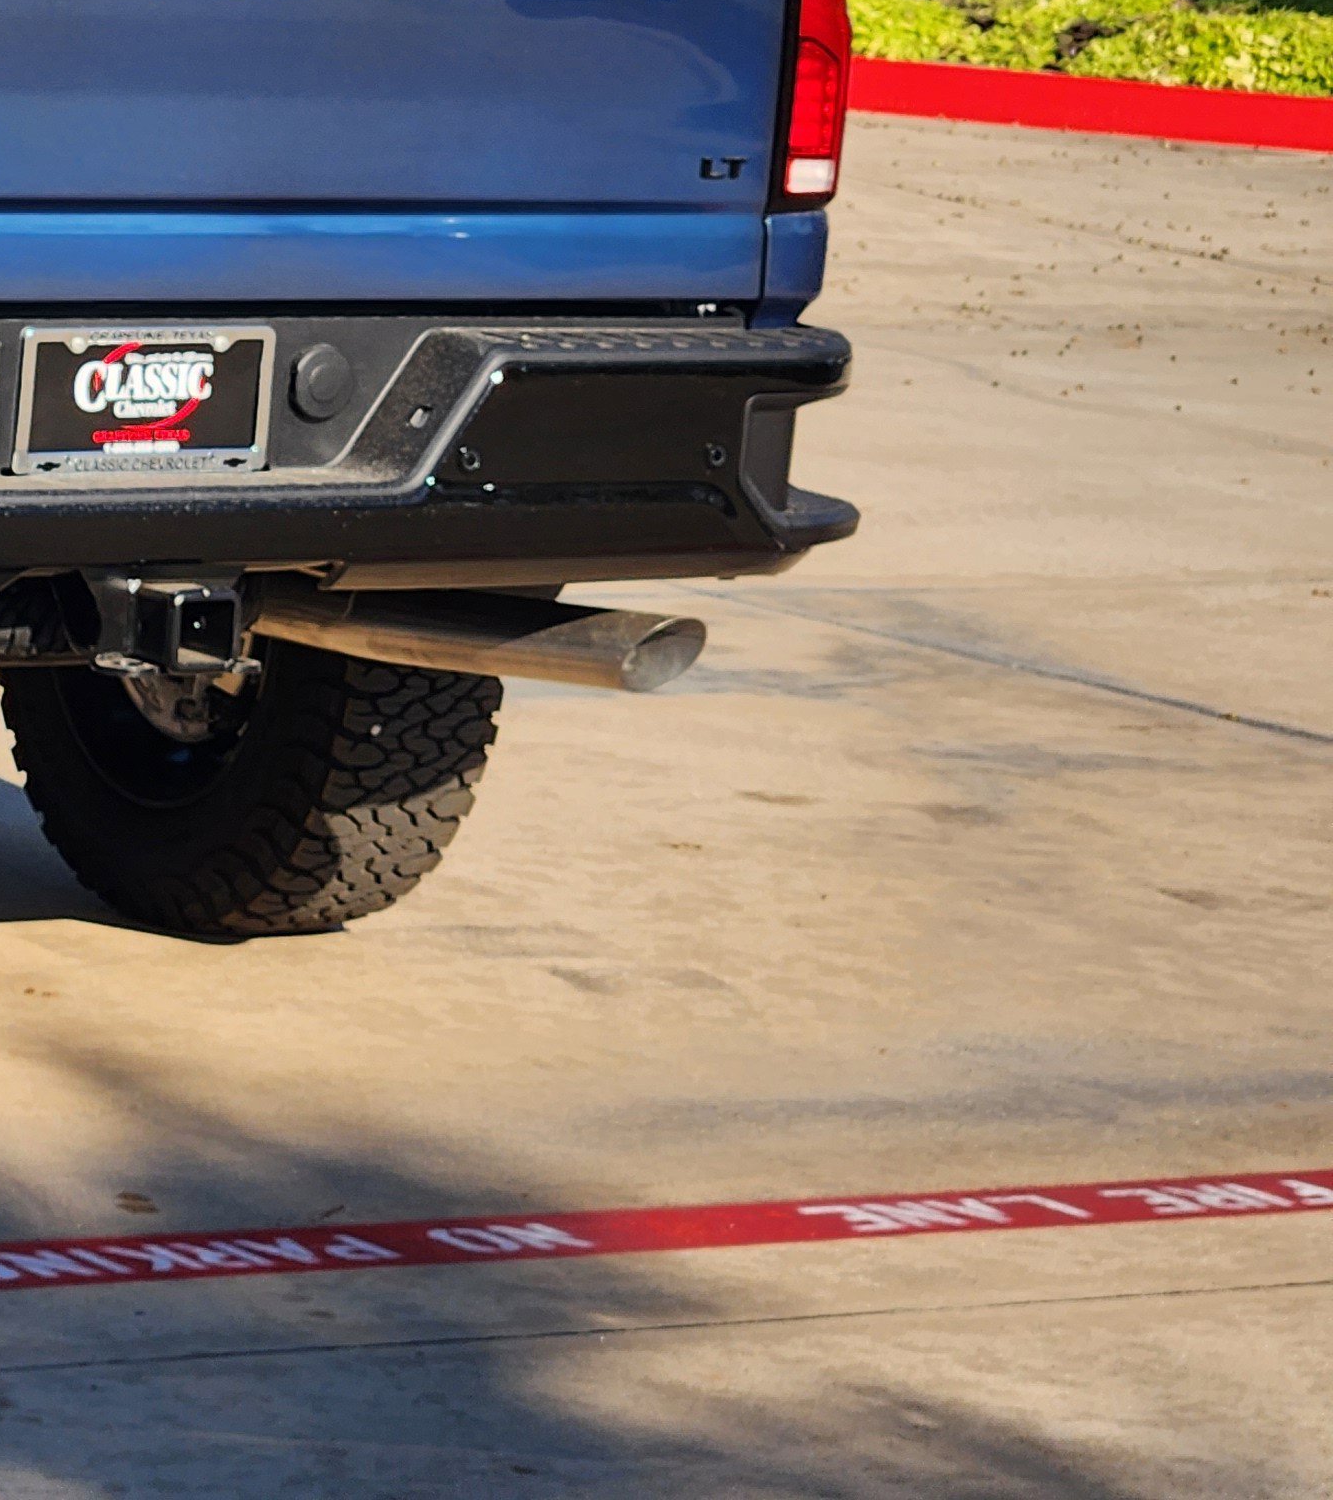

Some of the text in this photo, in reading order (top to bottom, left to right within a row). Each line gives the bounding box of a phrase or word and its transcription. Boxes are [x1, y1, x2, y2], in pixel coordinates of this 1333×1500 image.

[699, 156, 748, 180] LT
[74, 360, 214, 413] CLASSIC
[74, 456, 207, 471] CLASSIC CHEVROLET
[1099, 1178, 1333, 1214] FIRE
[797, 1194, 1091, 1233] LANE
[426, 1222, 595, 1253] NO
